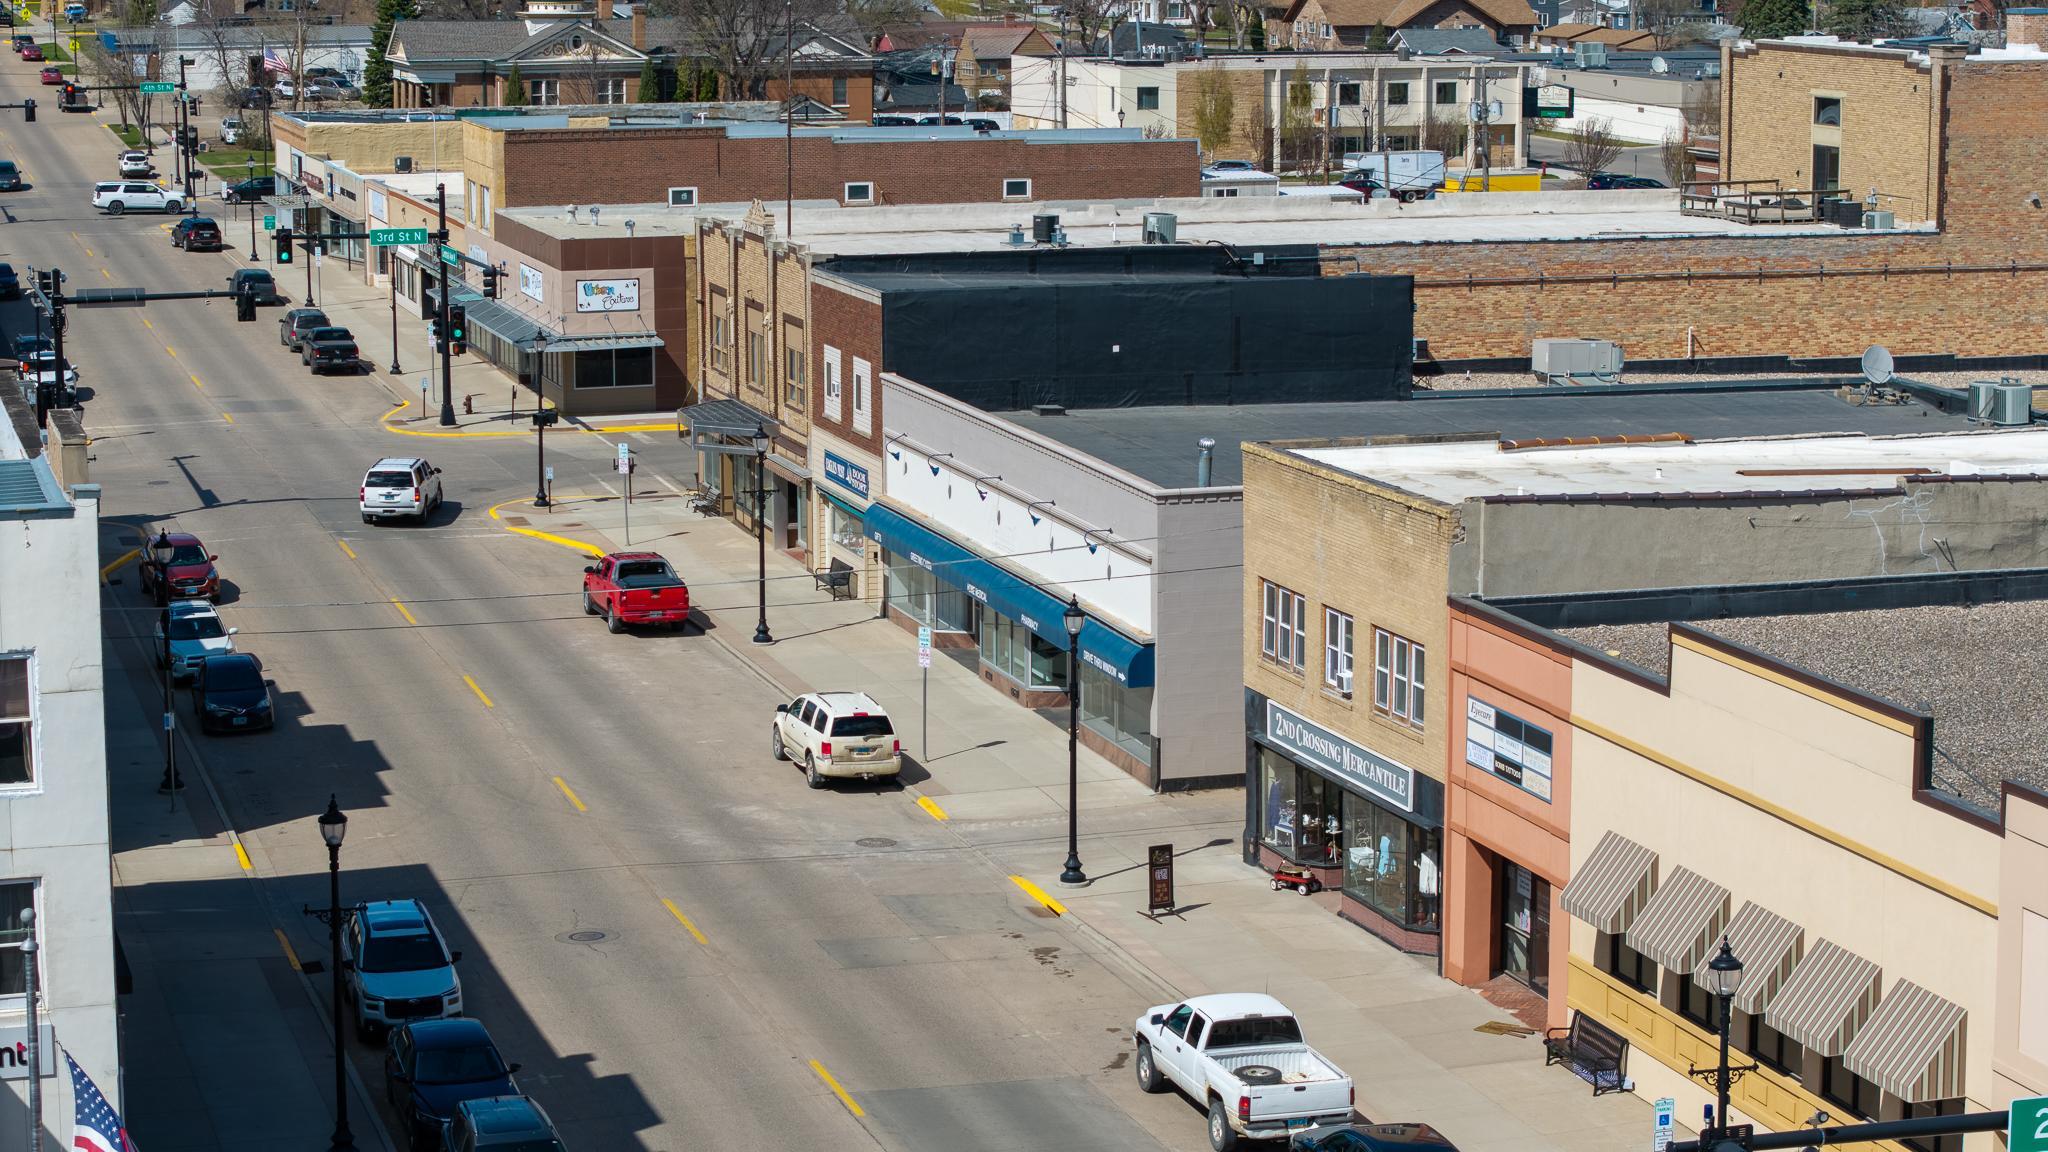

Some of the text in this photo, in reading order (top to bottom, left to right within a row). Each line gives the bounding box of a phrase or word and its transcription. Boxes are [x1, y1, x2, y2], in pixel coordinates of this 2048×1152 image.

[377, 231, 421, 242] 3rd St N
[852, 468, 866, 483] BOOK
[851, 479, 867, 493] STORE
[1021, 613, 1039, 632] PHARMACY
[1083, 649, 1117, 678] DRIVE THRU WINDOW
[1471, 701, 1492, 719] Eyecare
[1275, 712, 1406, 797] 2ND CROSSING MERCANTILE
[1505, 765, 1522, 779] TATTOOS
